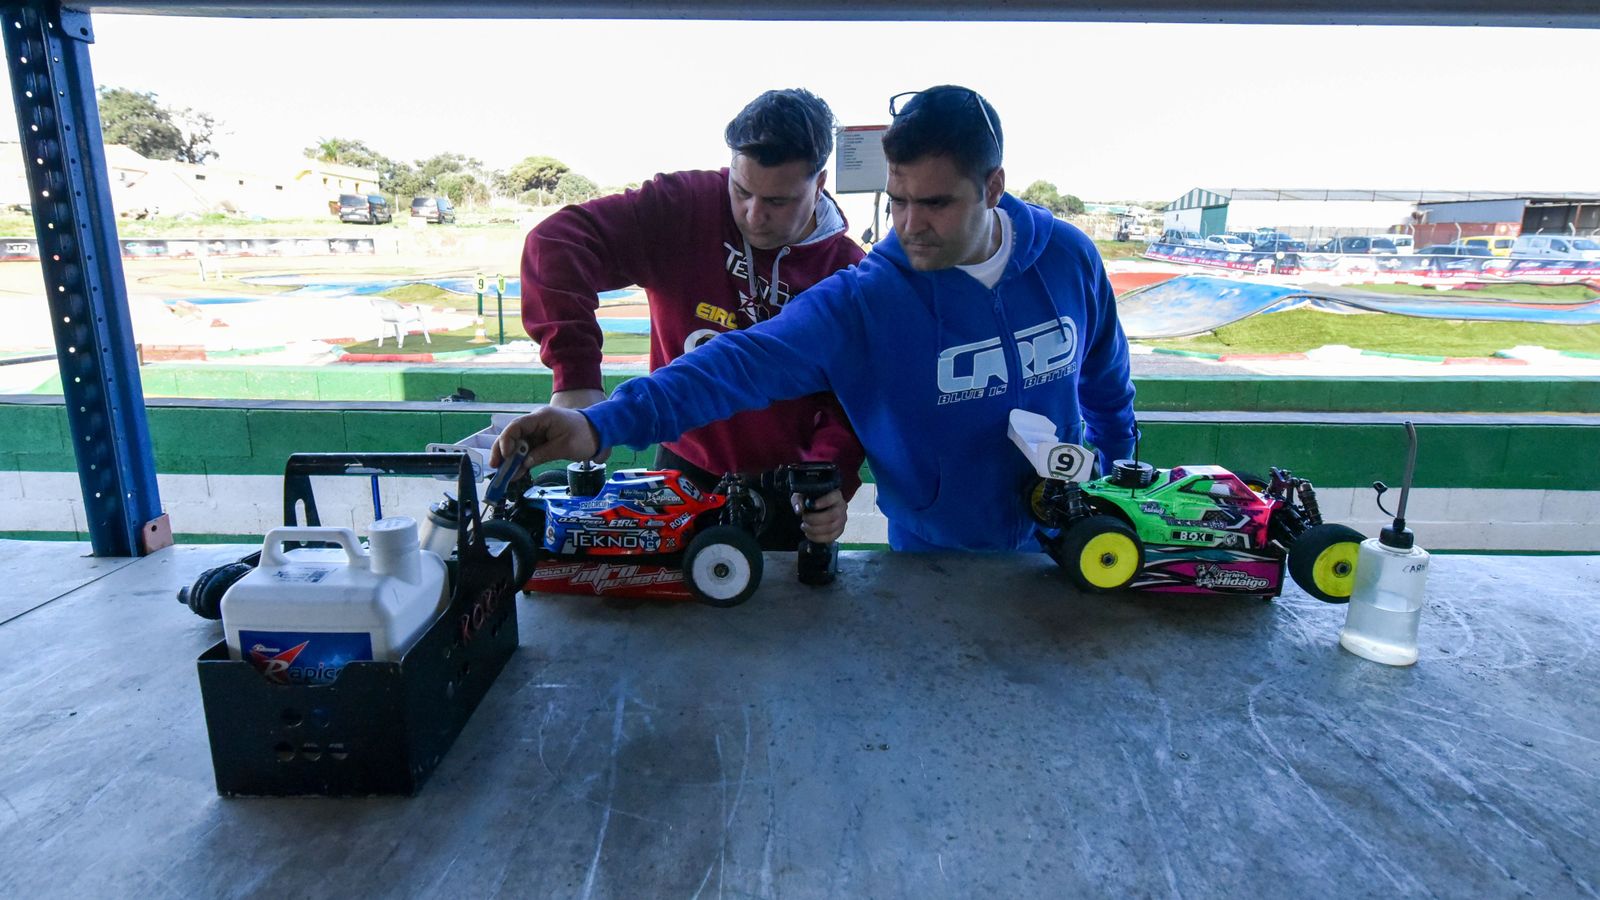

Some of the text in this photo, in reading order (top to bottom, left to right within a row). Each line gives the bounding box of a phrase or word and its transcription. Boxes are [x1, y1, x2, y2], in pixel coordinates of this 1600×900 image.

[478, 278, 484, 290] 9
[937, 362, 1077, 405] BLUE IS BETTER
[1055, 453, 1075, 472] 9
[1216, 577, 1267, 589] Hidalgo
